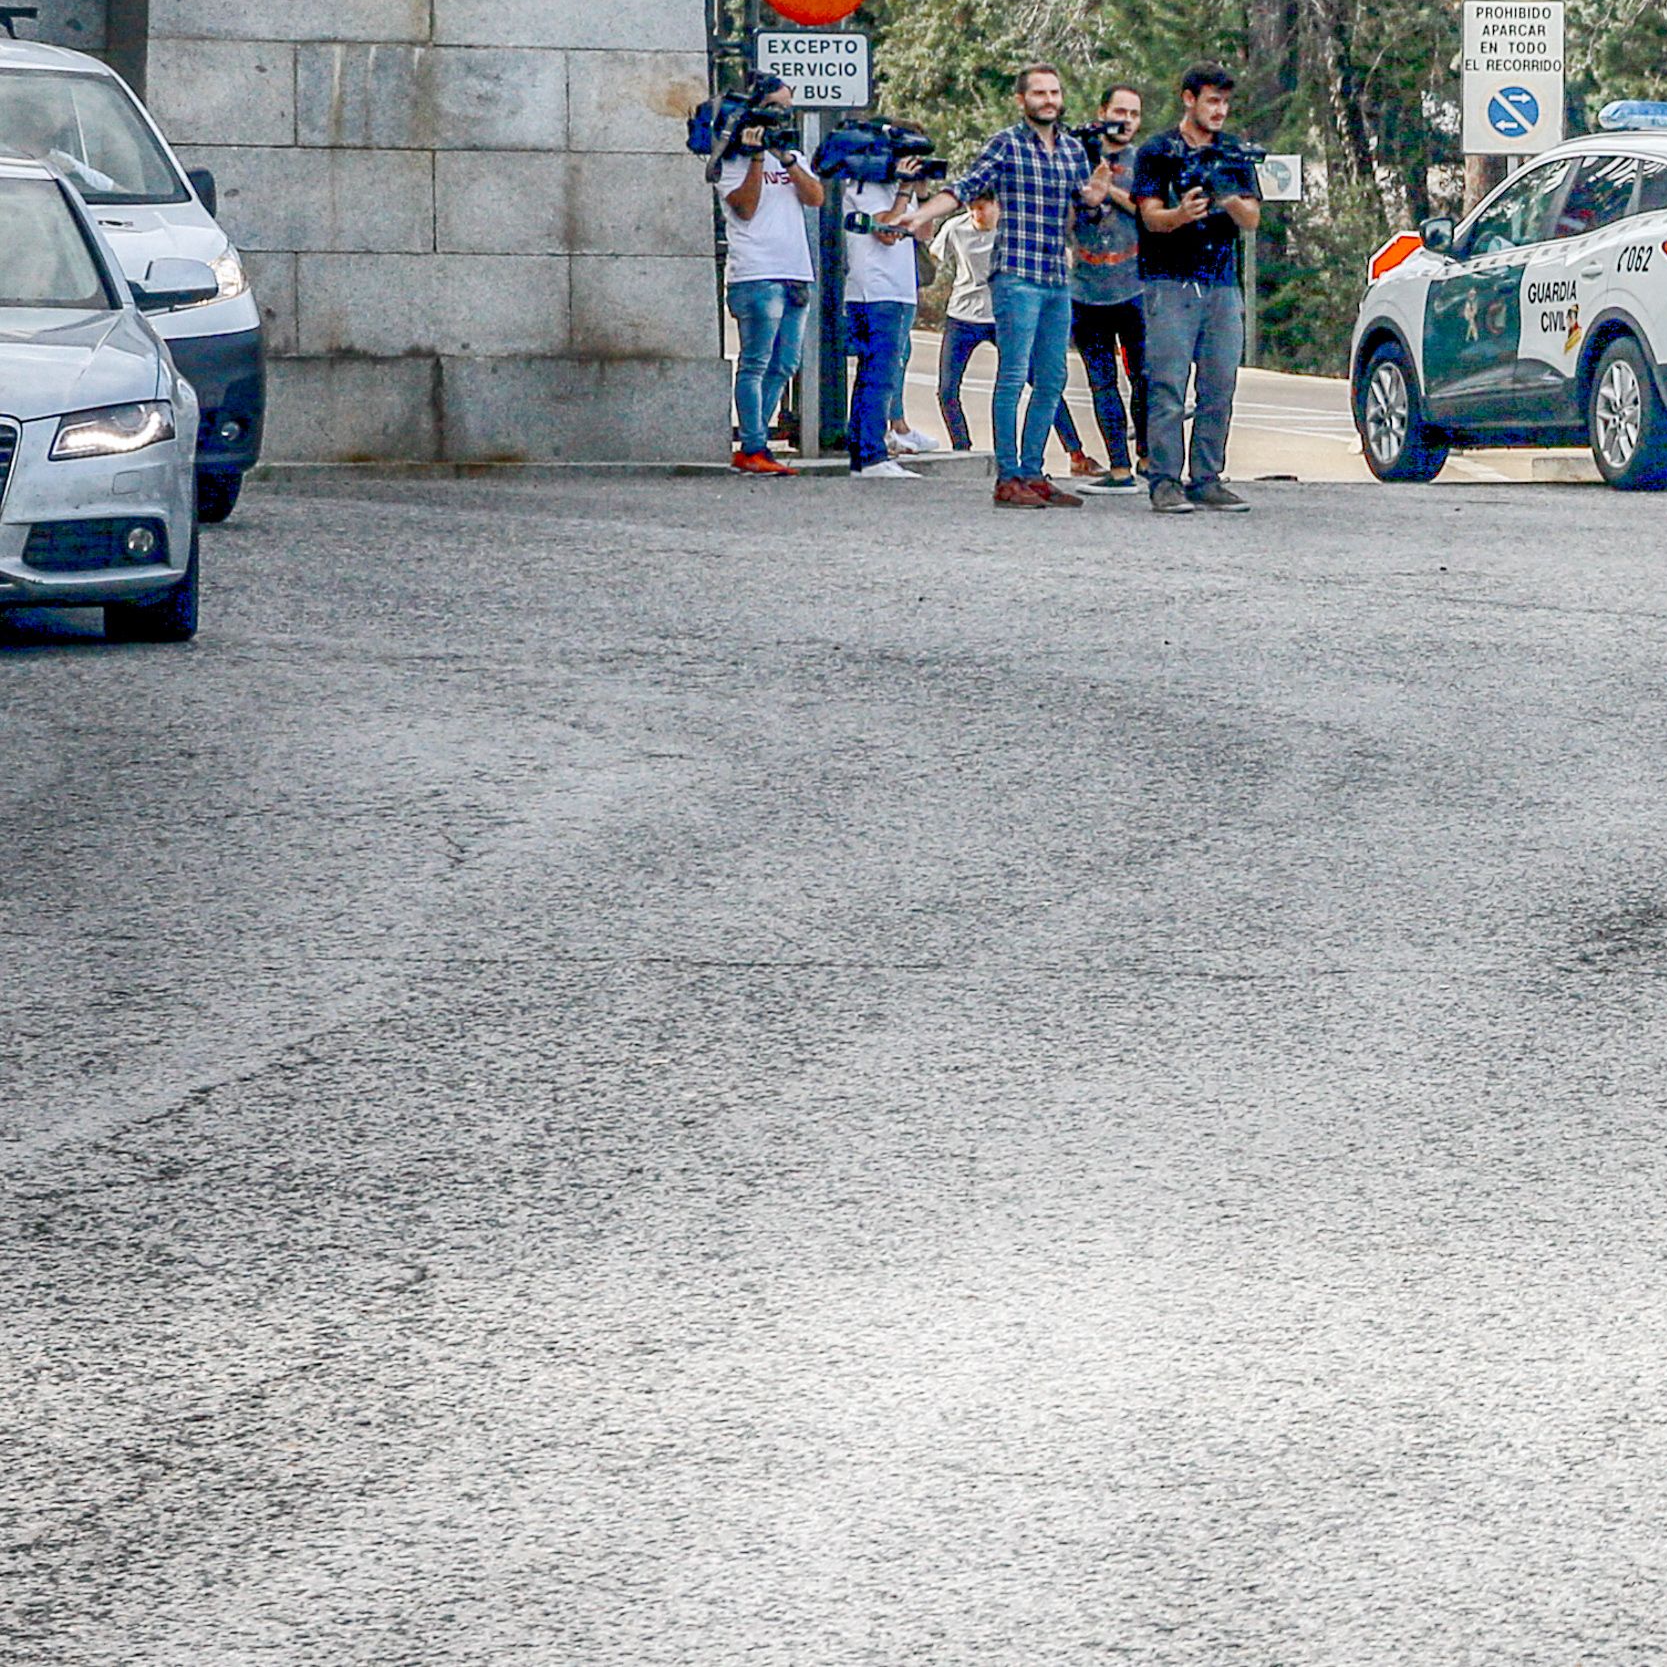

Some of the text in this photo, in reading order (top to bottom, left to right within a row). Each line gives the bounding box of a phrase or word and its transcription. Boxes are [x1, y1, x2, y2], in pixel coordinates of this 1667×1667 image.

[1475, 7, 1552, 19] PROHIBIDO
[1482, 24, 1547, 36] APARCAR
[768, 39, 858, 54] EXCEPTO
[1480, 41, 1547, 54] EN TODO
[769, 62, 858, 77] SERVICIO
[1464, 58, 1563, 72] EL RECORRIDO
[804, 85, 843, 100] BUS
[1626, 245, 1653, 273] 062
[1527, 279, 1577, 304] GUARDIA
[1540, 310, 1567, 333] CIVIL
